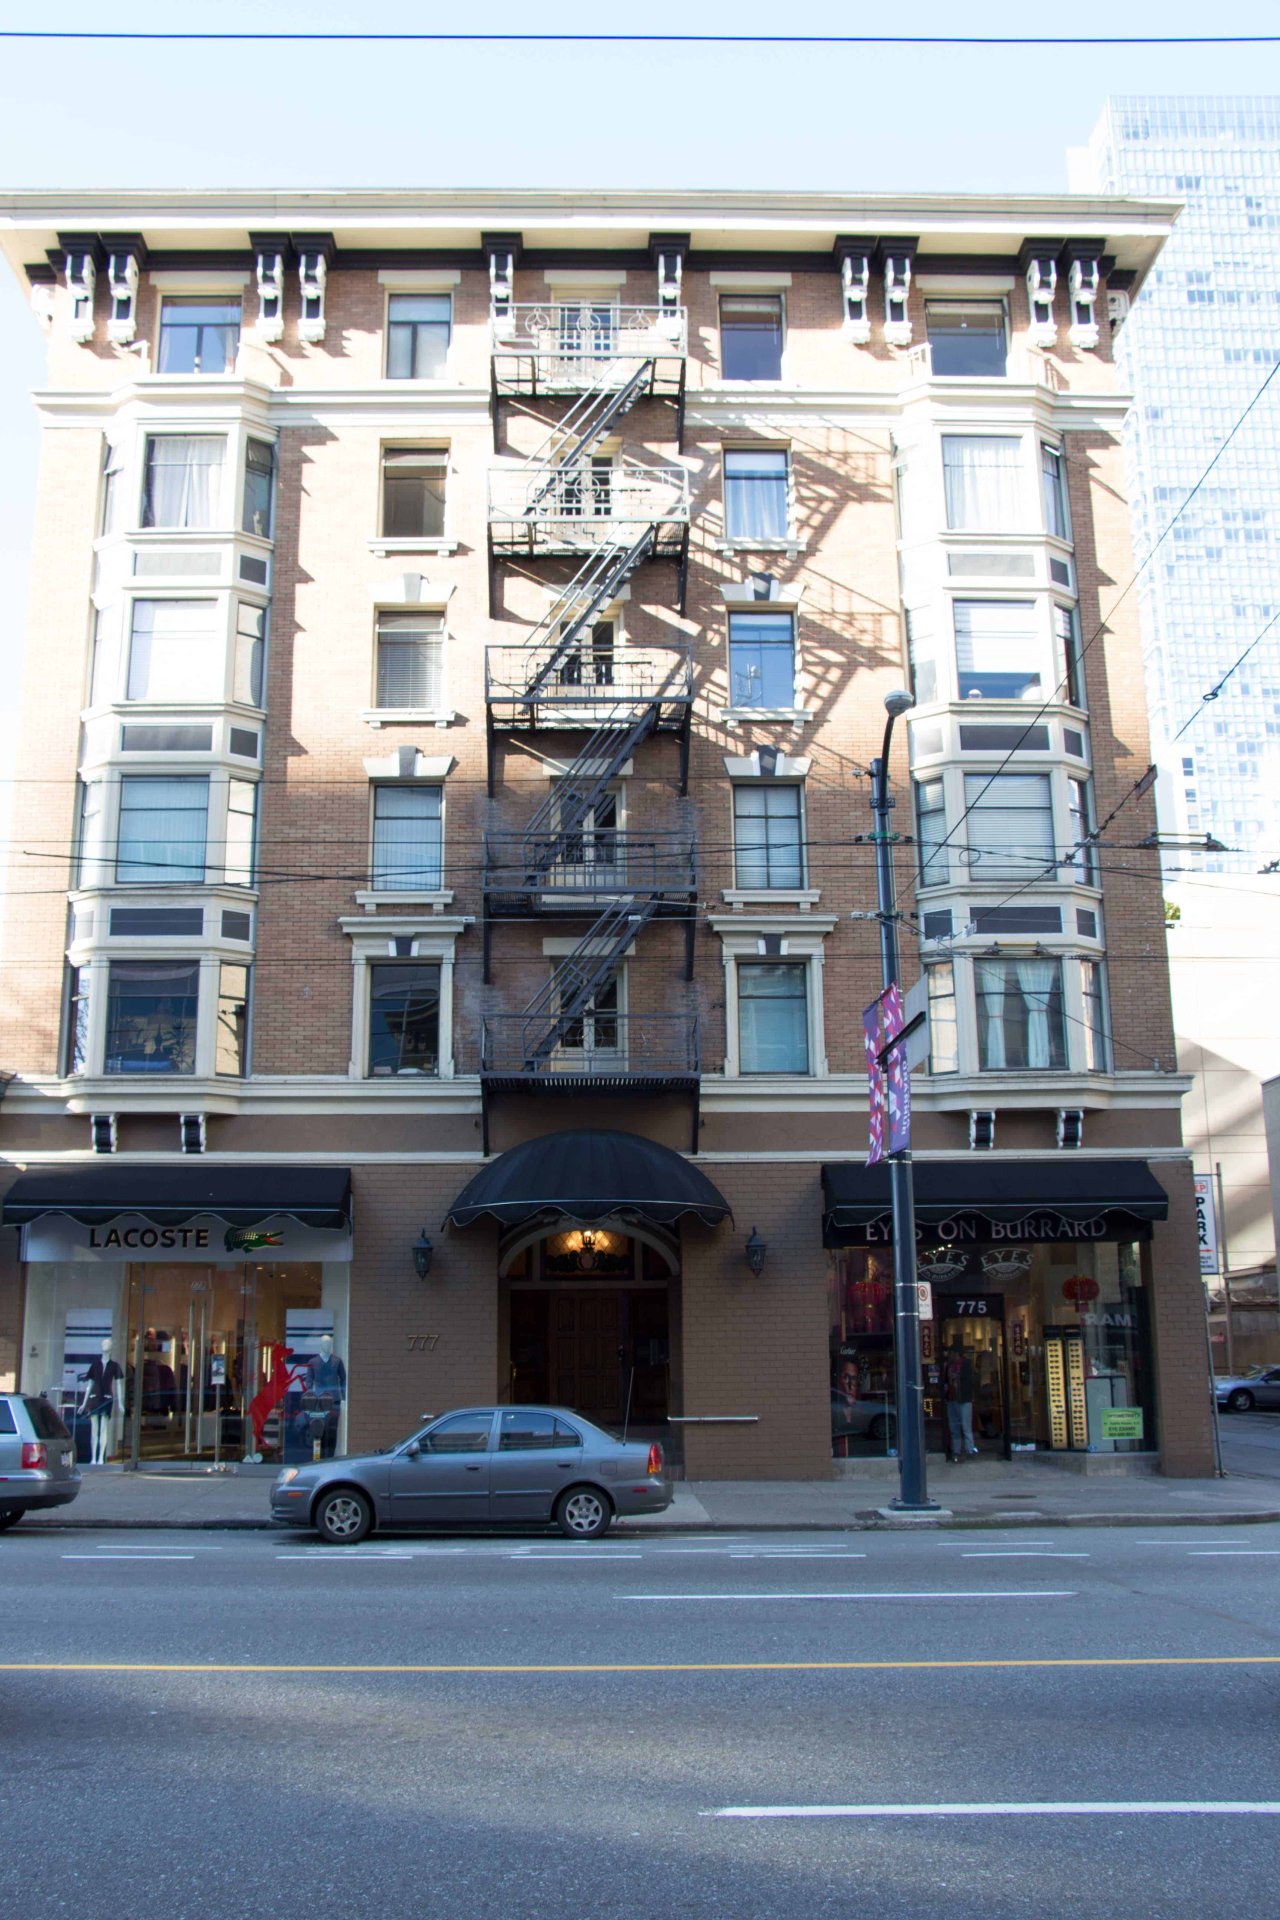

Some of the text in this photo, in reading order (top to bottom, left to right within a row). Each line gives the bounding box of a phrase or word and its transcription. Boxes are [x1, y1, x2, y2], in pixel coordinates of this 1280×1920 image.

[866, 1218, 1107, 1241] EYS ON BURRARD
[1195, 1197, 1208, 1245] PARK
[90, 1228, 209, 1248] LACOSTE
[980, 1251, 1035, 1268] EYES
[957, 1301, 987, 1314] 775
[408, 1334, 440, 1351] 777
